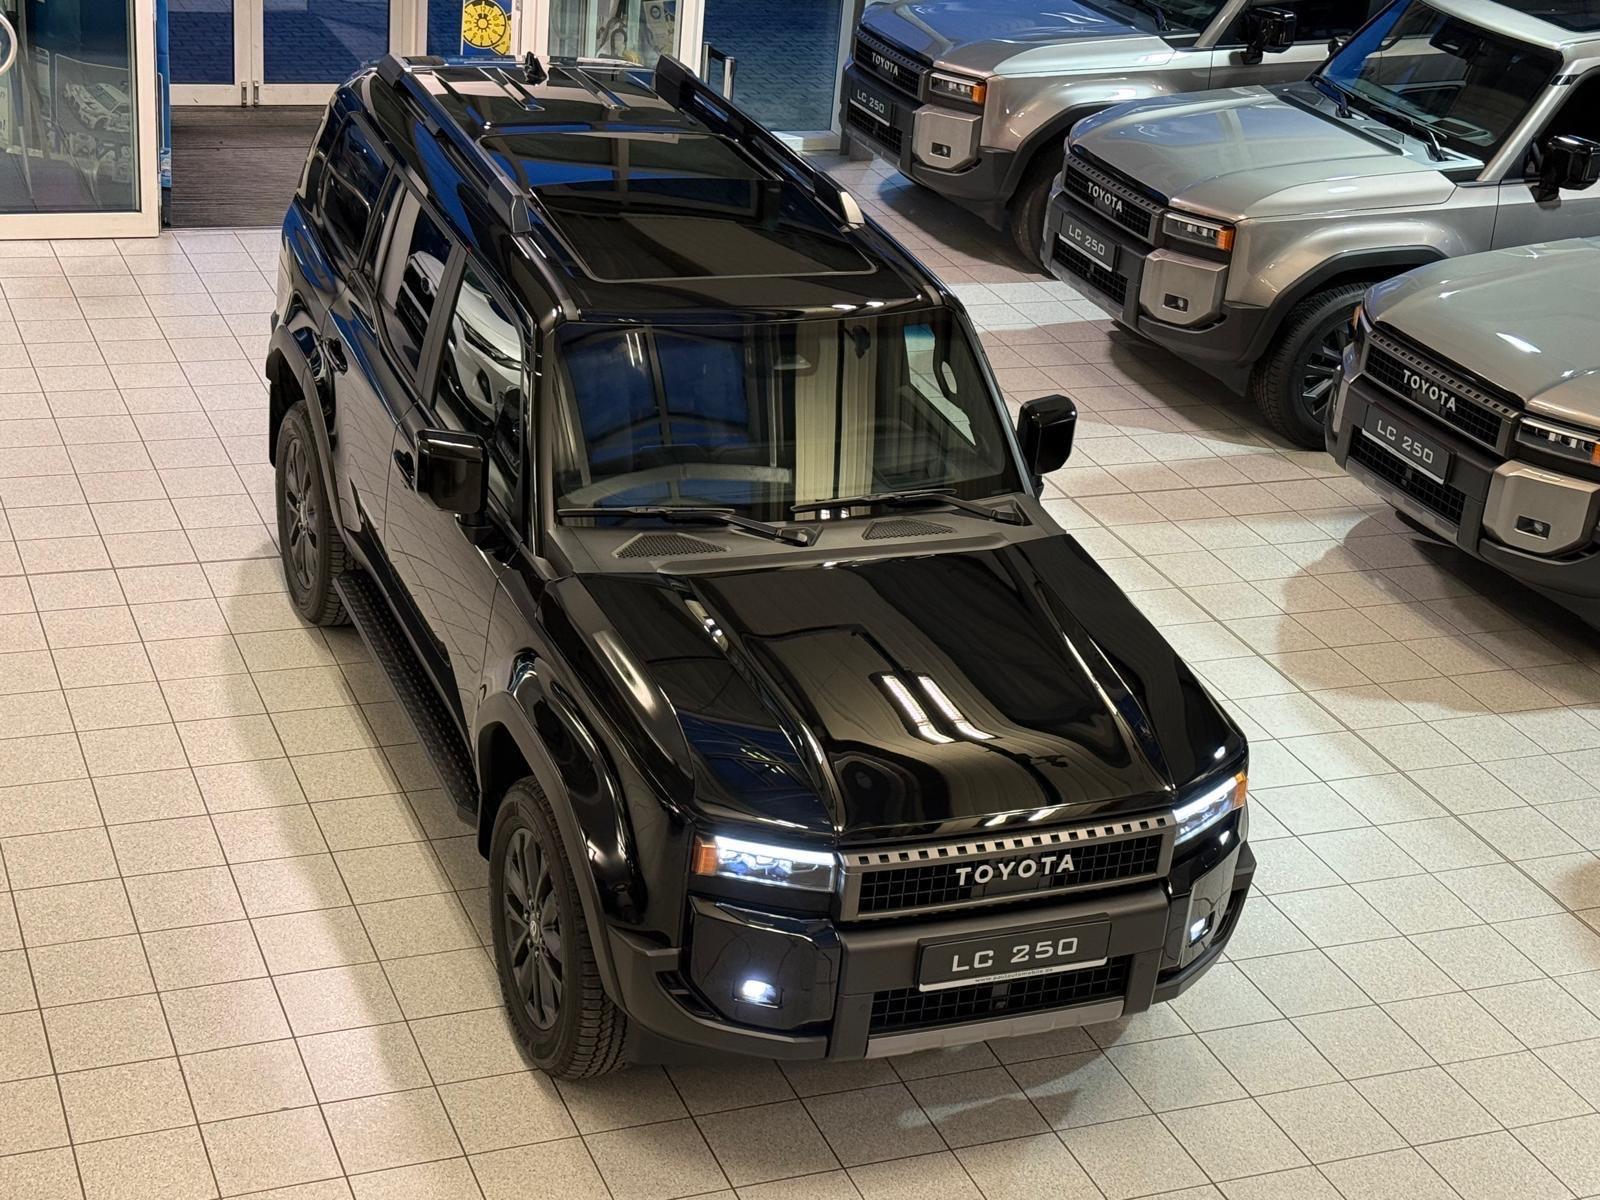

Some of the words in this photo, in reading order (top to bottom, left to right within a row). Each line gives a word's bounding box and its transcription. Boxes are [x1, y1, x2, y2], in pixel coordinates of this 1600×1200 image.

[871, 51, 898, 76] TOYOTA
[857, 89, 867, 103] LC
[869, 97, 885, 113] 250
[1088, 182, 1122, 212] TOYOTA
[1068, 224, 1082, 240] LC
[1084, 235, 1105, 256] 250
[1403, 369, 1456, 412] TOYOTA
[1377, 420, 1397, 441] LC
[1402, 435, 1434, 464] 250
[956, 854, 1075, 886] TOYOTA
[952, 950, 994, 972] LC
[1010, 937, 1078, 963] 250
